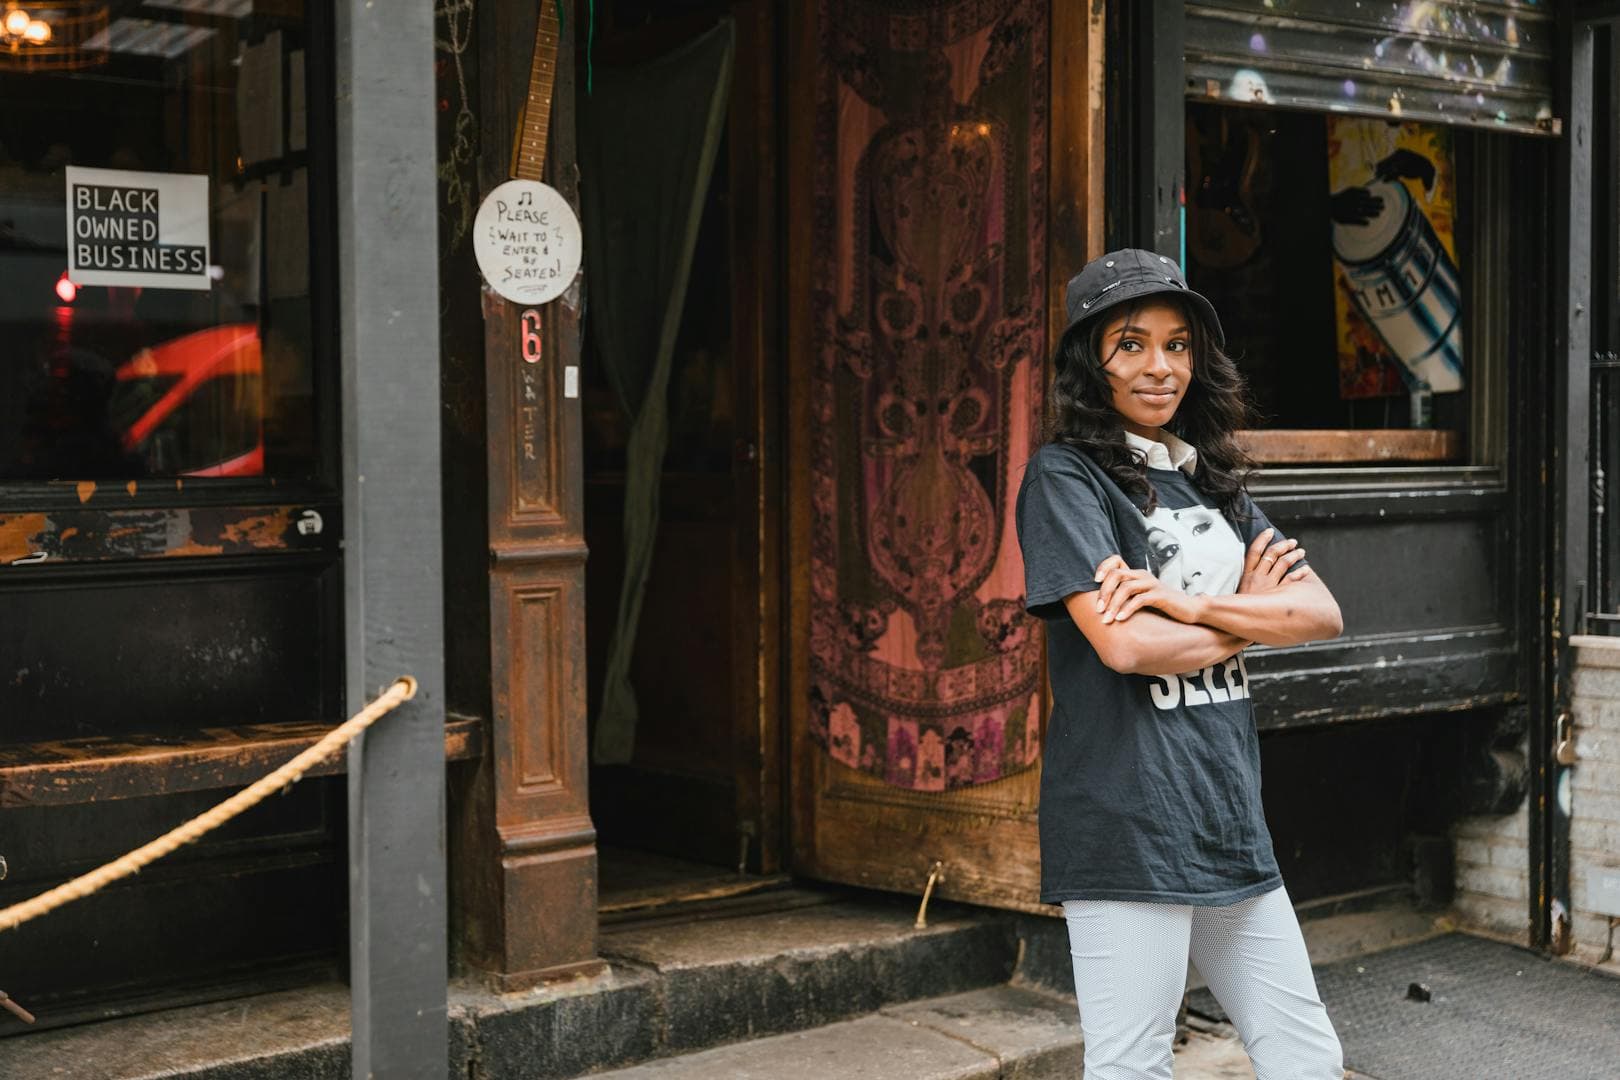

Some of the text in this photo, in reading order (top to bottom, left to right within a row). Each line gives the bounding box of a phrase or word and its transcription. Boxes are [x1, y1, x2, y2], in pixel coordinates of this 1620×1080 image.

[76, 186, 157, 213] BLACK
[496, 200, 549, 226] PLEASE
[76, 215, 157, 241] OWNED
[498, 228, 548, 243] WAIT TO
[77, 244, 204, 272] BUSINESS
[502, 245, 538, 256] ENTER
[502, 258, 561, 283] SEATED!
[521, 308, 542, 364] 6
